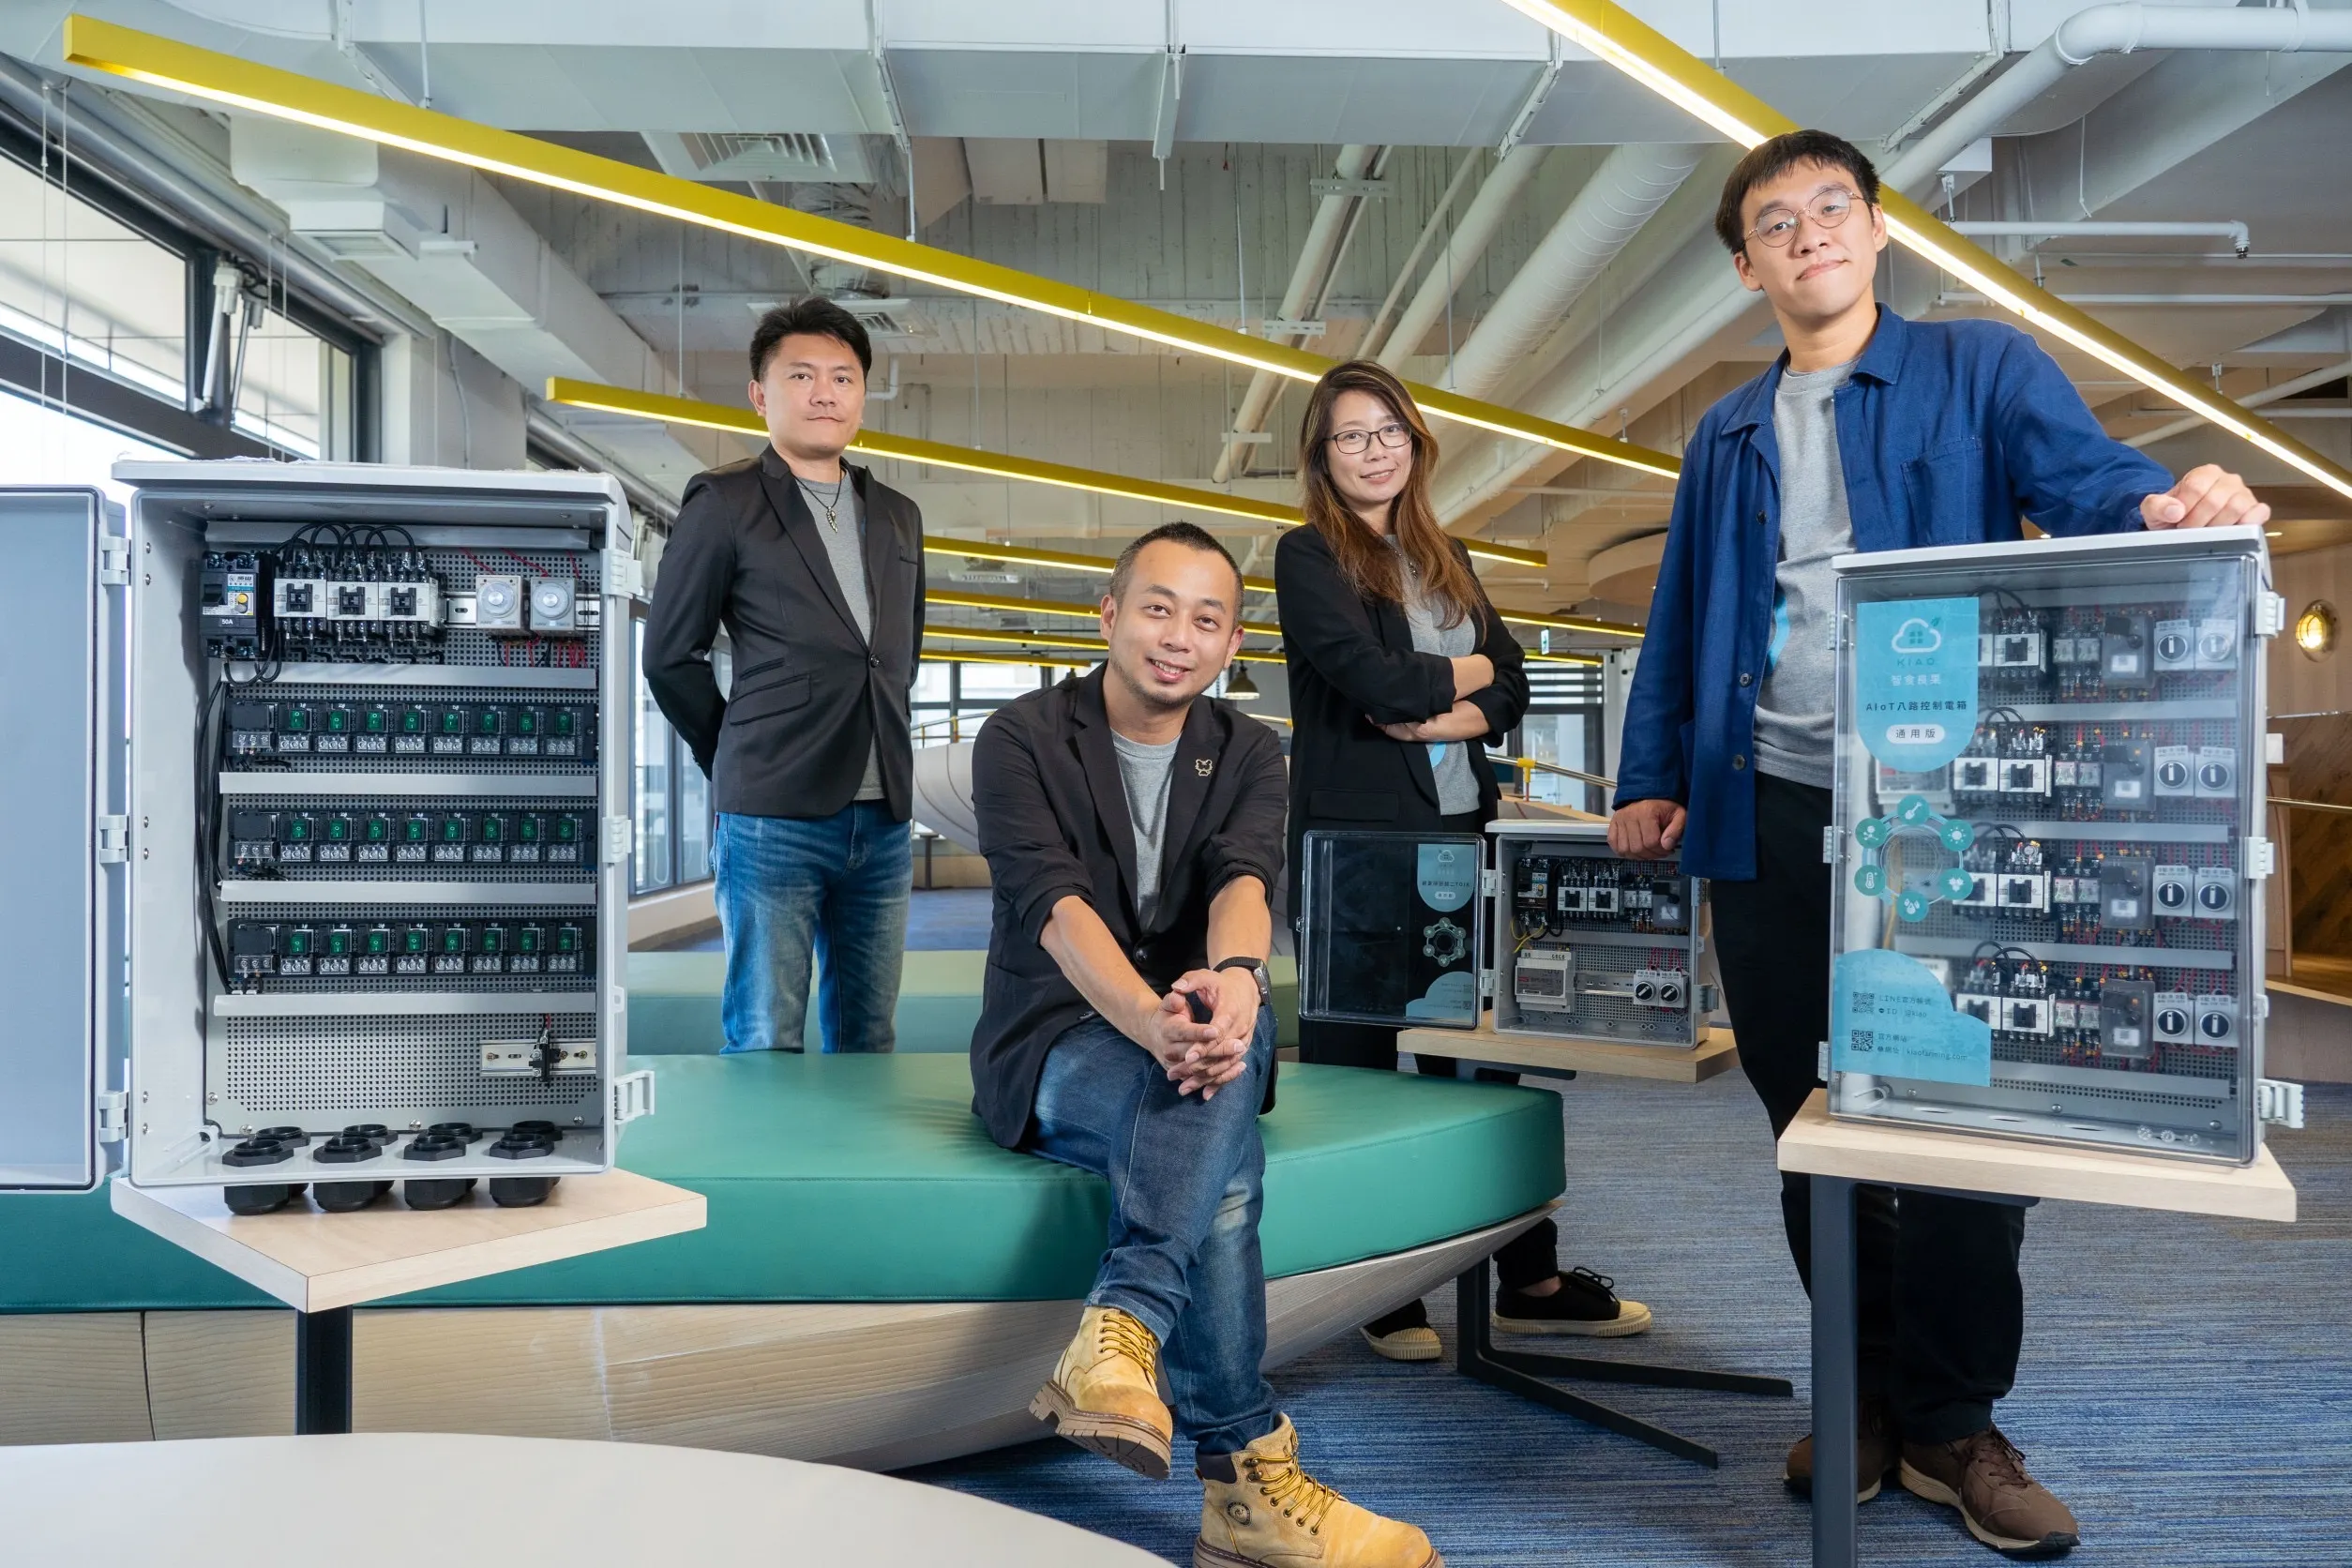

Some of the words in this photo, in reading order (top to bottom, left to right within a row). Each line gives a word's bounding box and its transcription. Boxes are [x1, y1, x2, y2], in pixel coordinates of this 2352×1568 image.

[1897, 657, 1936, 668] KIAO
[1866, 701, 1968, 712] AIoT八路控制電箱
[1895, 728, 1936, 739] 通用版
